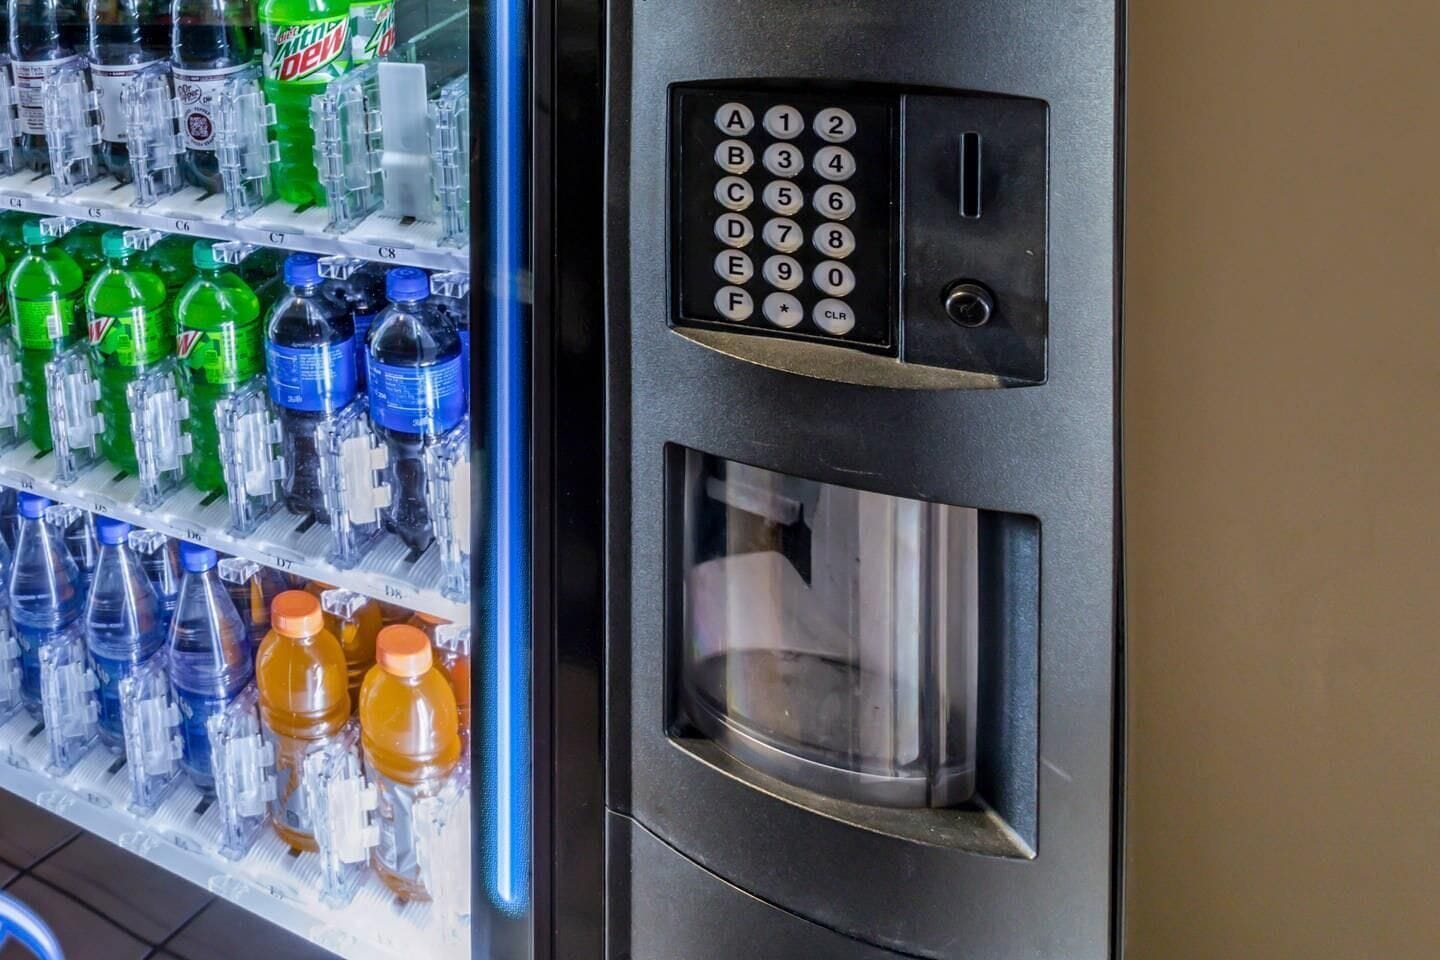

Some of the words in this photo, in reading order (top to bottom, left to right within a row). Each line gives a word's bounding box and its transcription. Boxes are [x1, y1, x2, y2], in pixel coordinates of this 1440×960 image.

[727, 110, 745, 129] A
[779, 113, 789, 131] 1
[829, 116, 844, 134] 2
[728, 146, 745, 165] B
[778, 150, 792, 168] 3
[828, 155, 843, 173] 4
[728, 183, 745, 202] C
[778, 188, 792, 205] 5
[829, 192, 843, 210] 6
[10, 198, 22, 208] C4
[88, 208, 101, 218] C5
[175, 221, 190, 232] C6
[728, 220, 745, 238] D
[778, 225, 792, 242] 7
[269, 232, 284, 243] C7
[828, 230, 843, 248] 8
[378, 247, 396, 259] C8
[729, 256, 744, 275] E
[778, 263, 792, 280] 9
[828, 268, 843, 286] 0
[729, 292, 744, 311] F
[824, 311, 847, 321] CLR
[187, 529, 201, 541] D6
[276, 556, 292, 570] D7
[385, 585, 402, 600] D8
